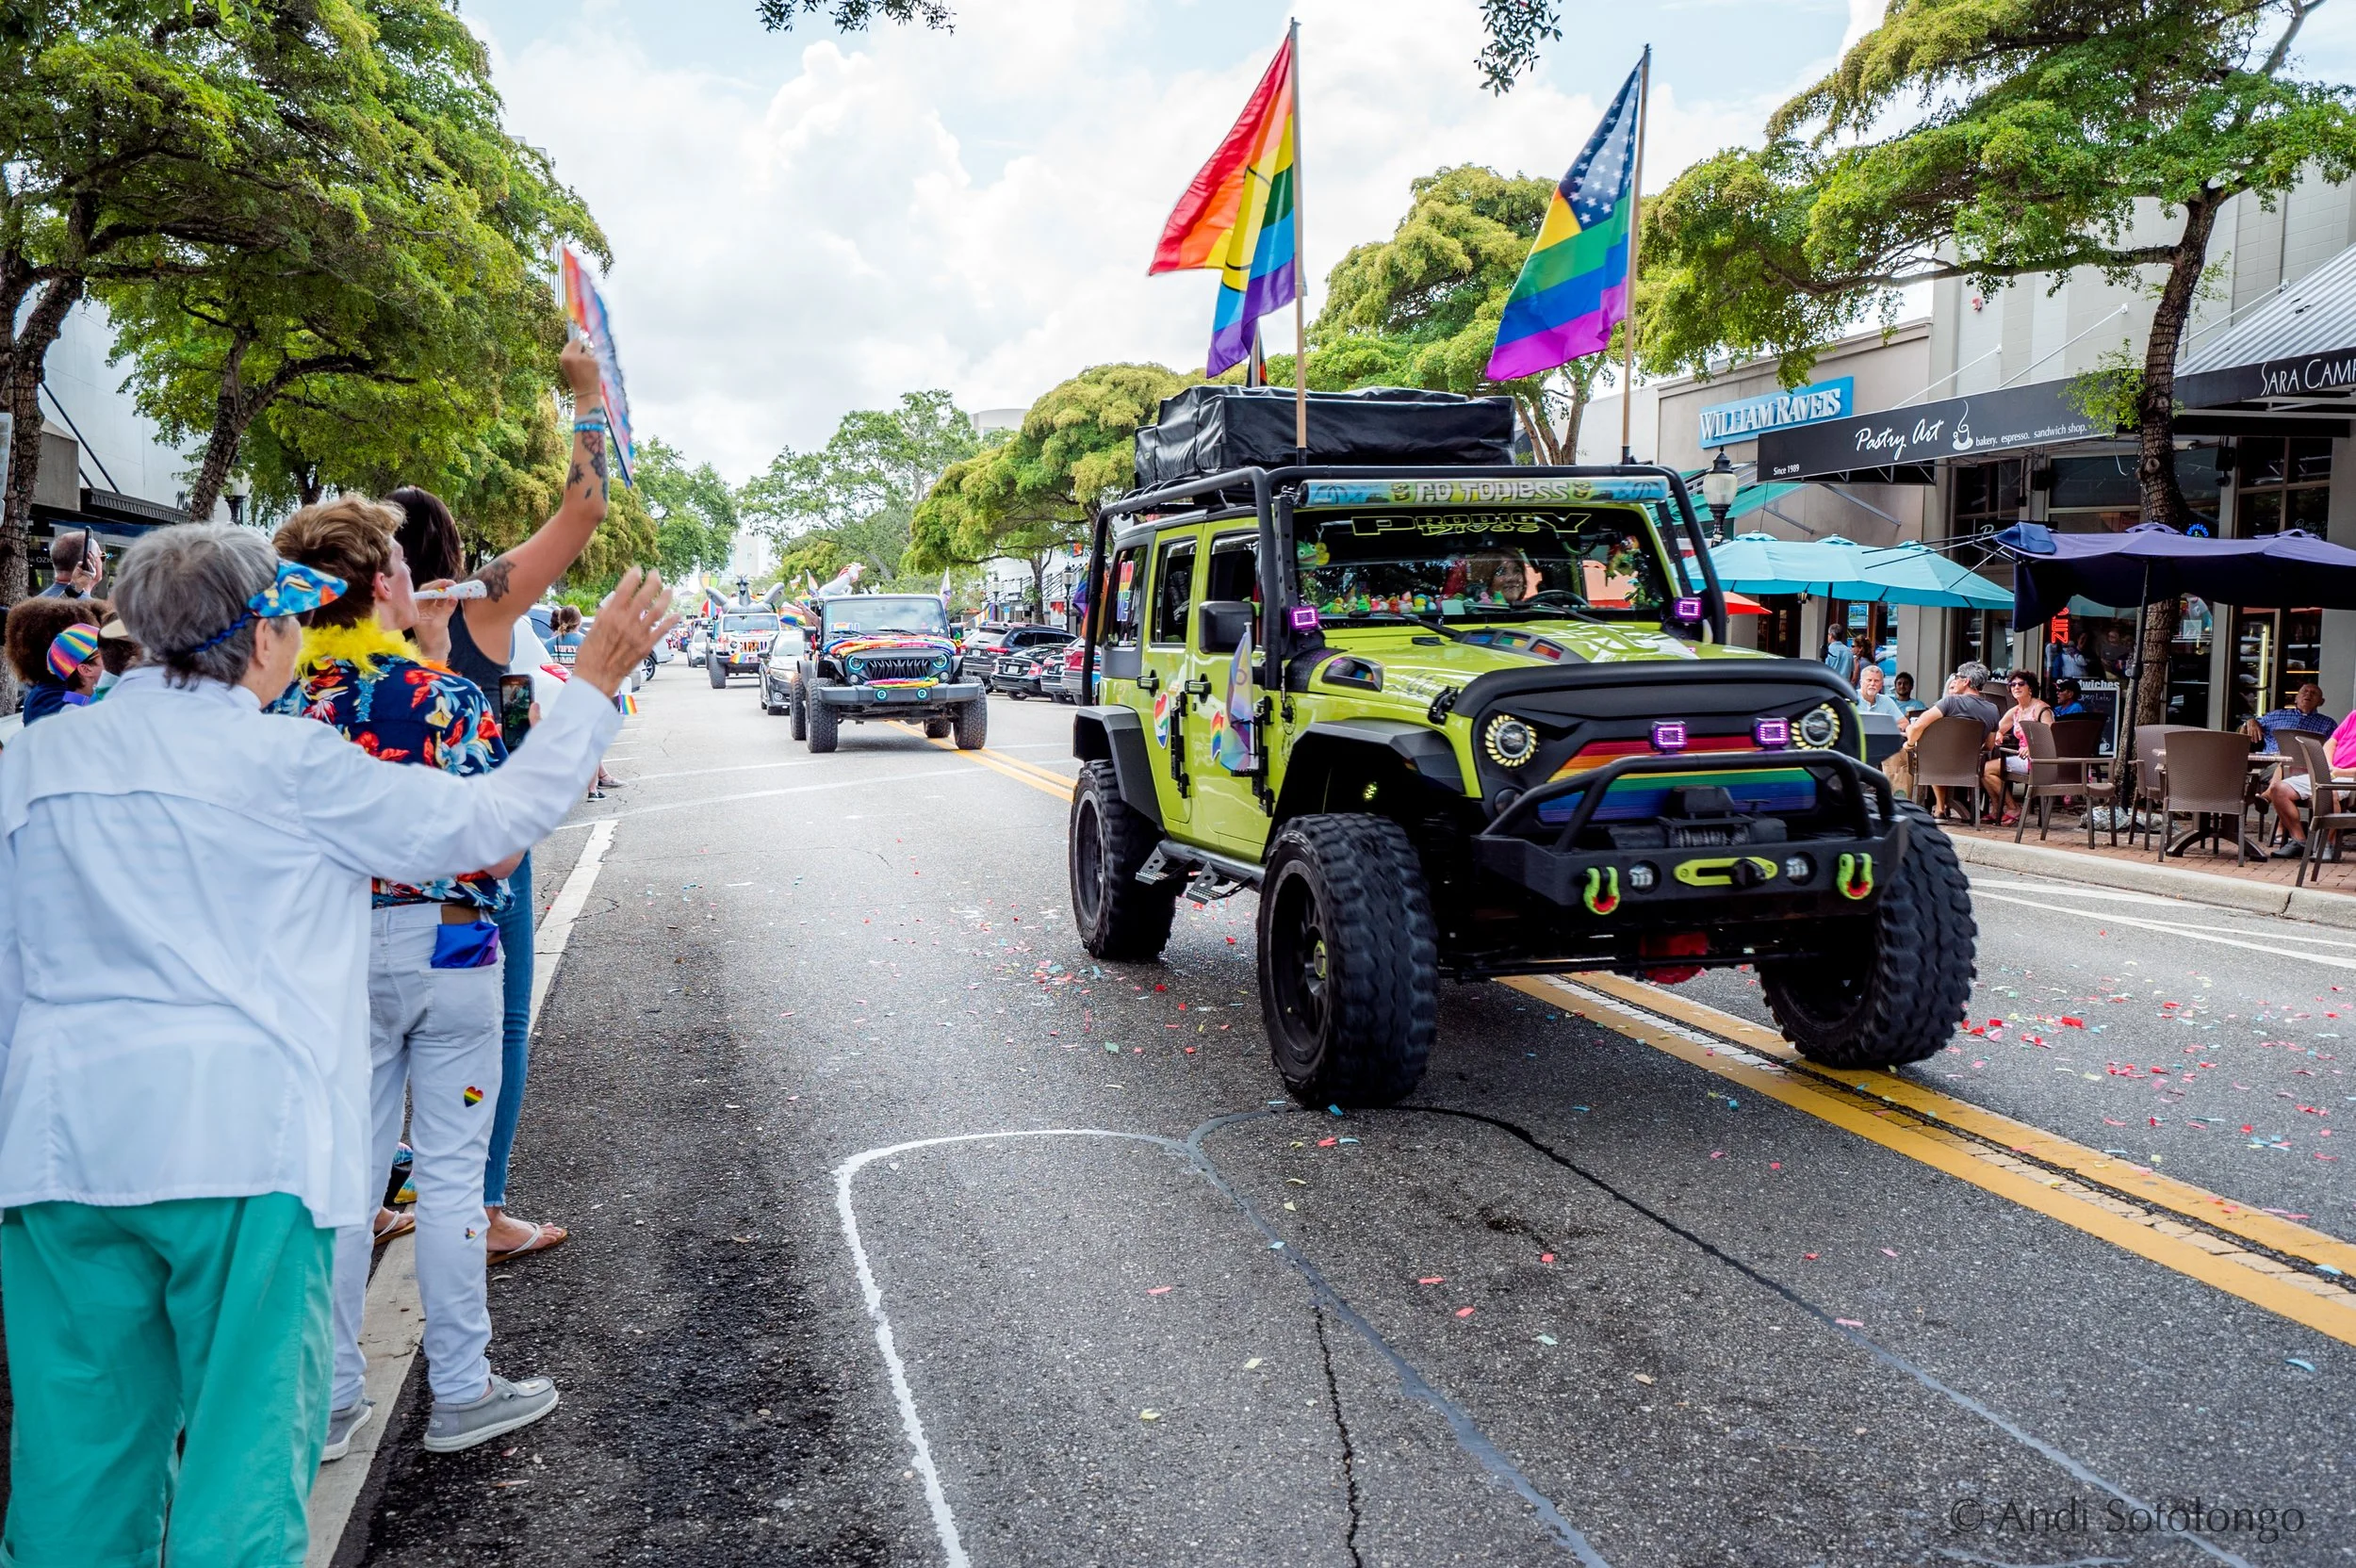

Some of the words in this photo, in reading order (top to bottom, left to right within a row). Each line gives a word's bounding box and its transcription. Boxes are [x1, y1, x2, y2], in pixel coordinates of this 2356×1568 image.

[2260, 362, 2299, 396] SARA
[1699, 401, 1775, 440] WILLIAM
[1774, 388, 1841, 424] RAVEIS
[1856, 427, 1906, 461] Pastry
[1912, 418, 1944, 445] Art
[1975, 434, 1998, 448] bakery.
[2034, 423, 2066, 438] sandwich
[1773, 466, 1787, 476] Since
[1787, 463, 1800, 473] 1989
